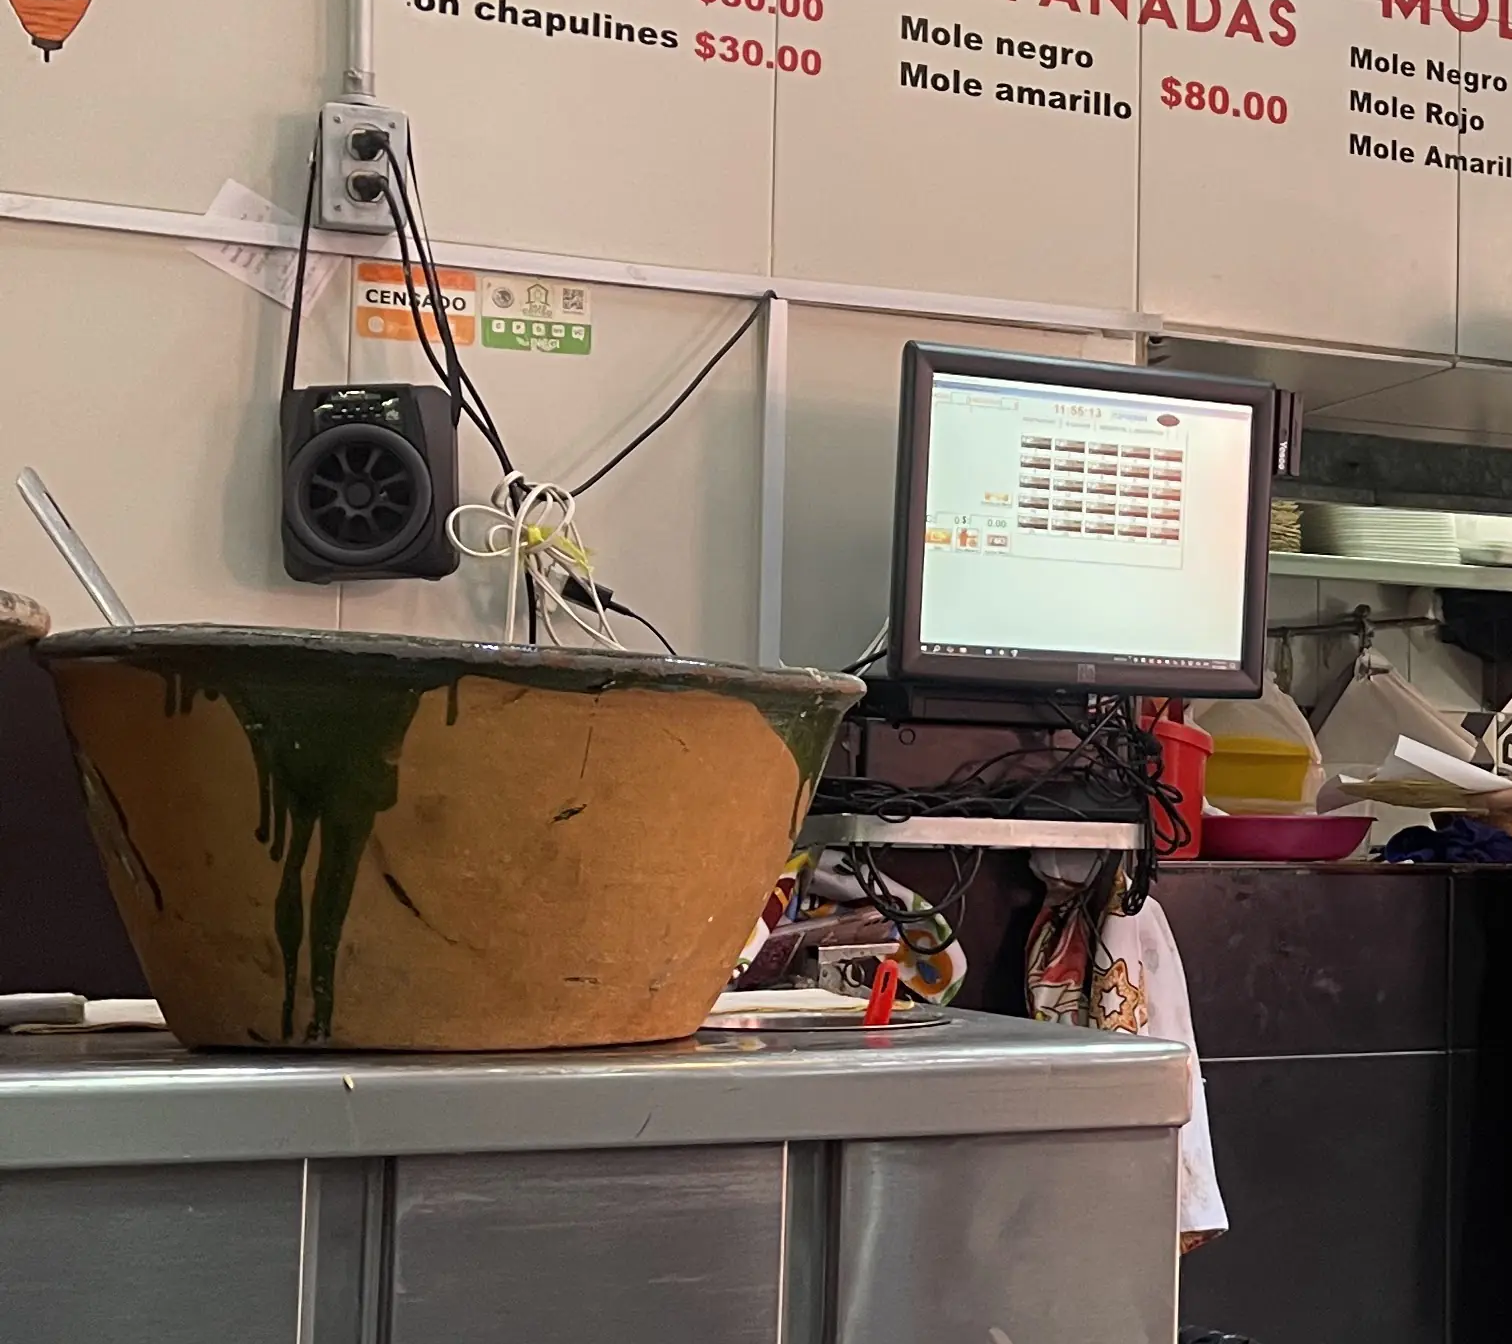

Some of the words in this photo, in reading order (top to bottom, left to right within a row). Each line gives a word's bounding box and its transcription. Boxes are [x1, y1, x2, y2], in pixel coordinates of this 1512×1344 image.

[694, 31, 822, 76] $30.00
[901, 14, 984, 51] Mole
[996, 36, 1094, 70] negro
[1350, 46, 1416, 77] Mole
[1426, 59, 1508, 93] Negro
[900, 61, 983, 98] Mole
[995, 81, 1132, 120] amarillo
[1160, 76, 1288, 125] $80.00
[1350, 90, 1415, 120] Mole
[1426, 103, 1485, 135] Rojo
[1349, 133, 1415, 164] Mole
